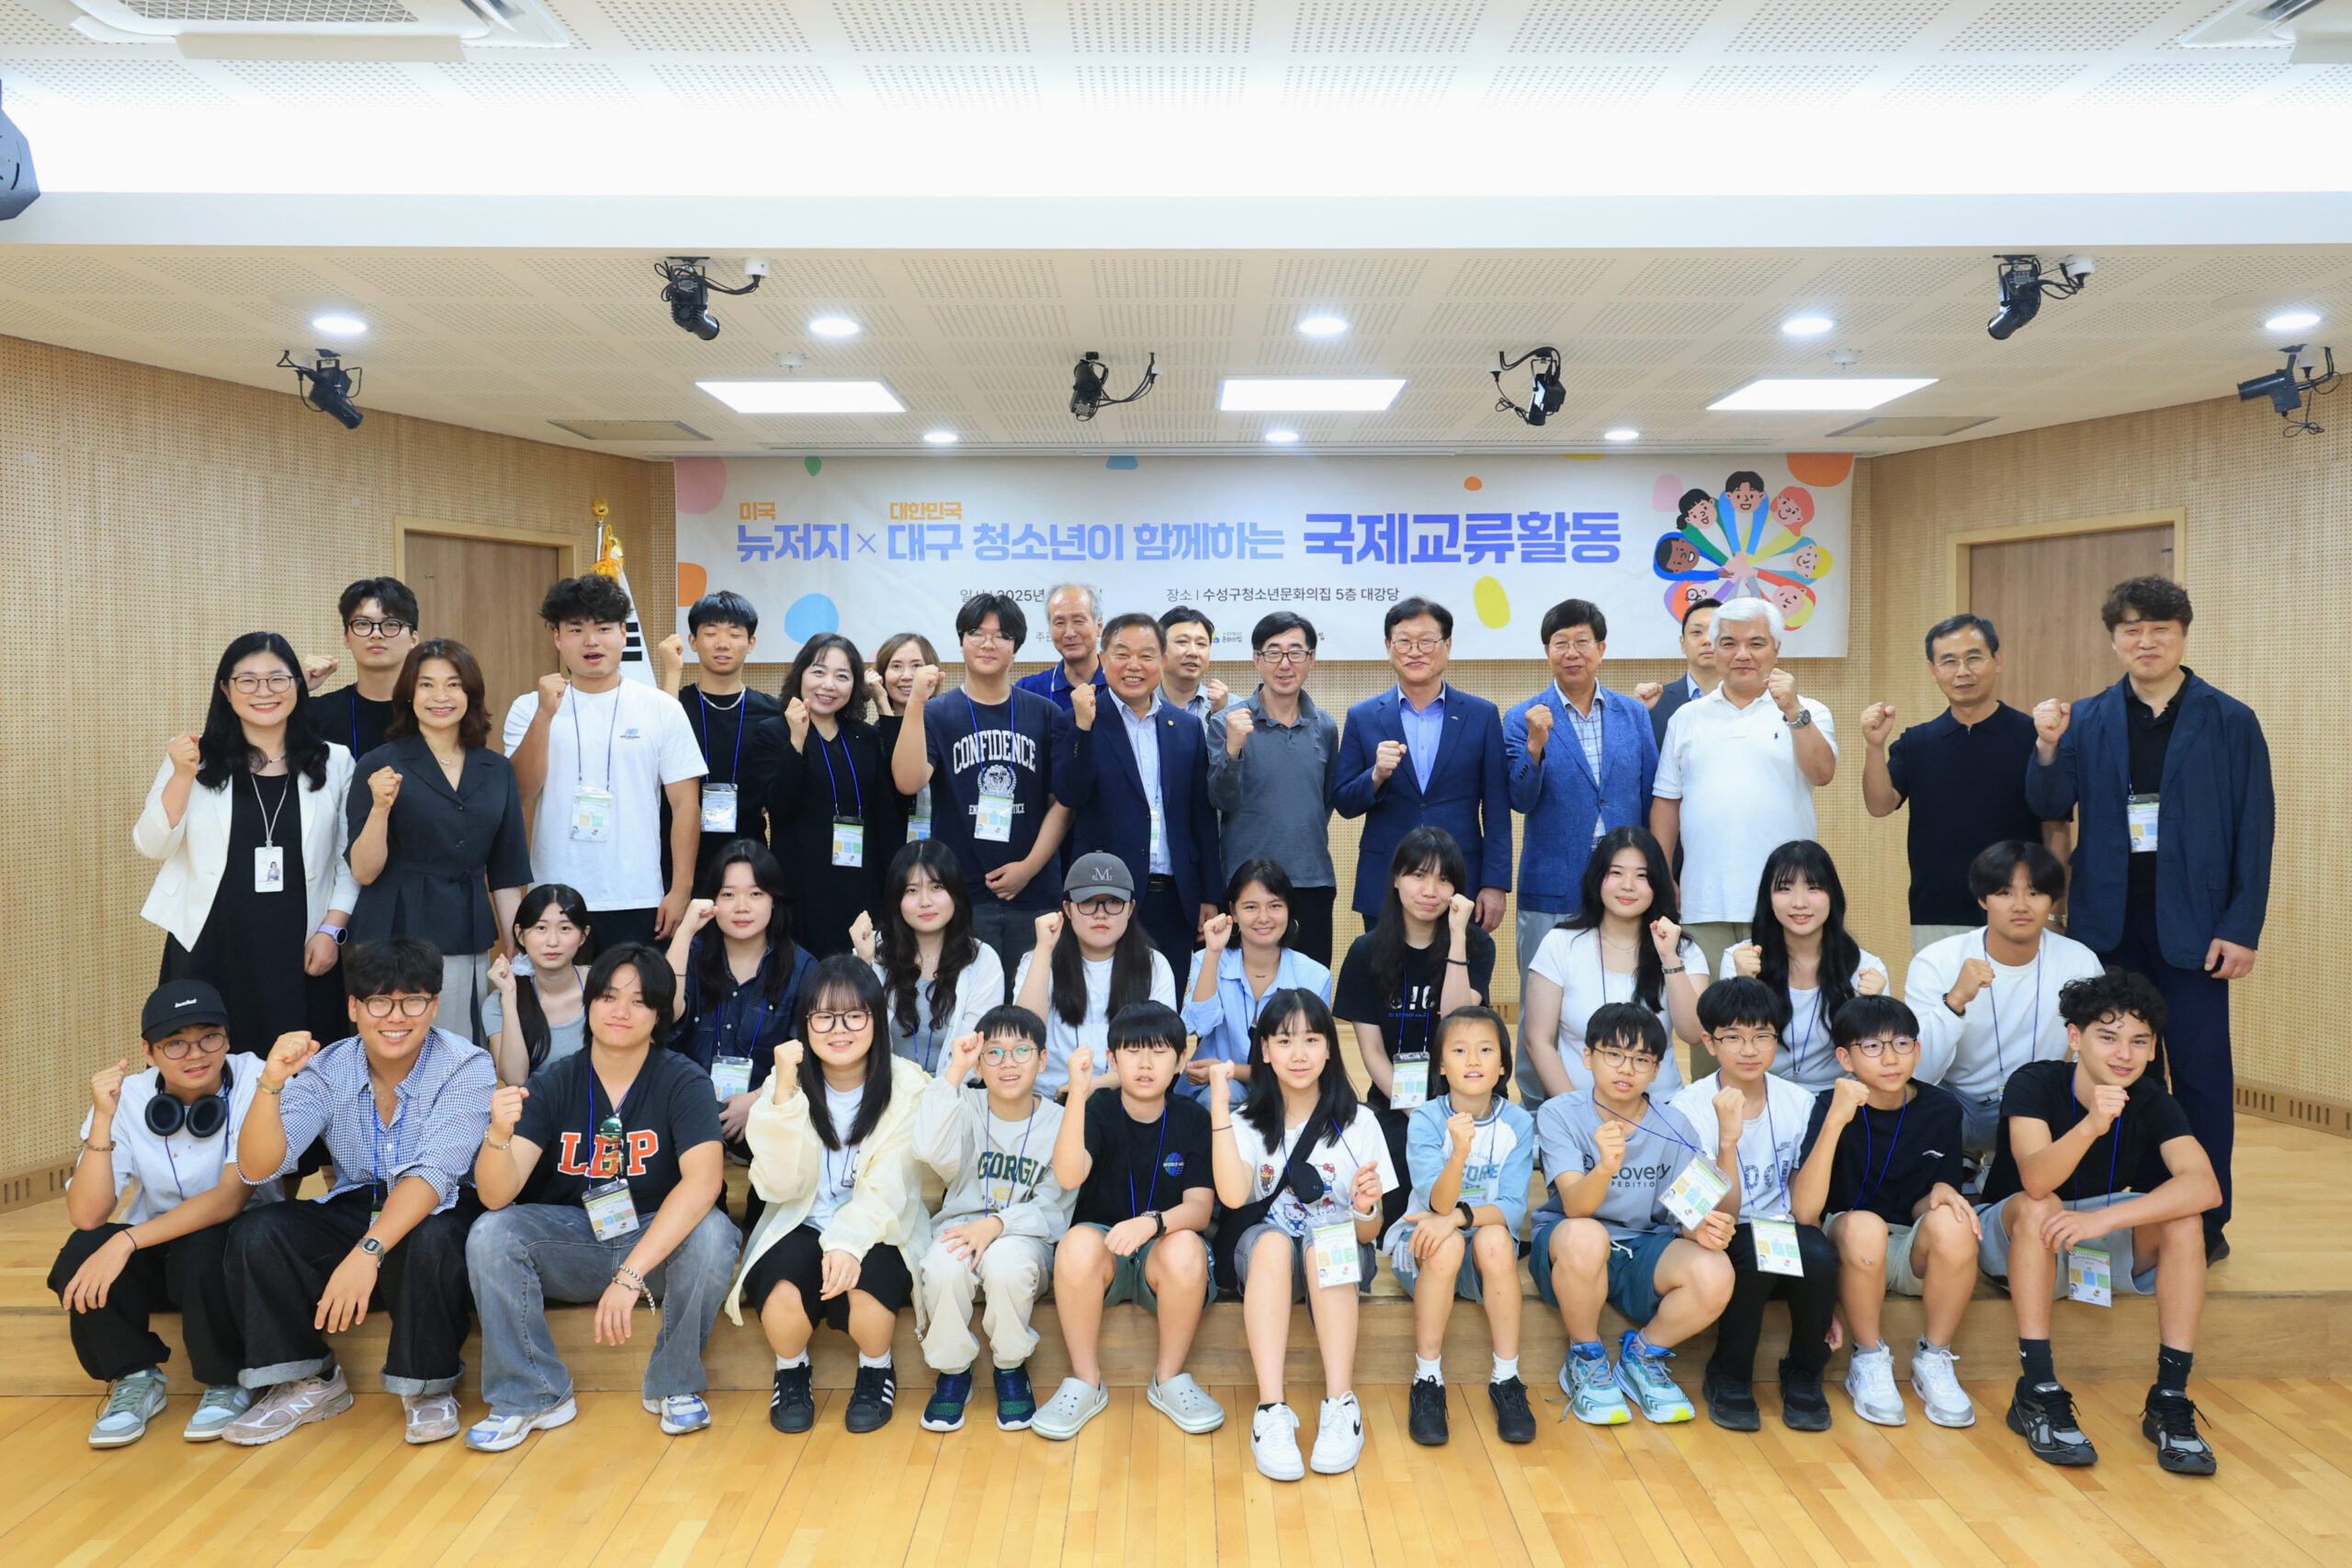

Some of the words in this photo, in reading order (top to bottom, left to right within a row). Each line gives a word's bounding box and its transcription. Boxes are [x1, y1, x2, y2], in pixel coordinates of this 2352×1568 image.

[739, 502, 776, 521] 미국
[889, 502, 963, 521] 대한민국
[737, 523, 850, 563] 뉴저지
[888, 523, 964, 562] 대구
[972, 523, 1124, 562] 청소년이
[1134, 522, 1284, 561] 함께하는
[1303, 511, 1622, 565] 국제교류활동
[1167, 588, 1193, 603] 장소
[1203, 587, 1332, 602] 수성구청소년문화의집
[1336, 588, 1358, 602] 5층
[1361, 587, 1399, 603] 대강당
[953, 729, 1036, 775] CONFIDENCE
